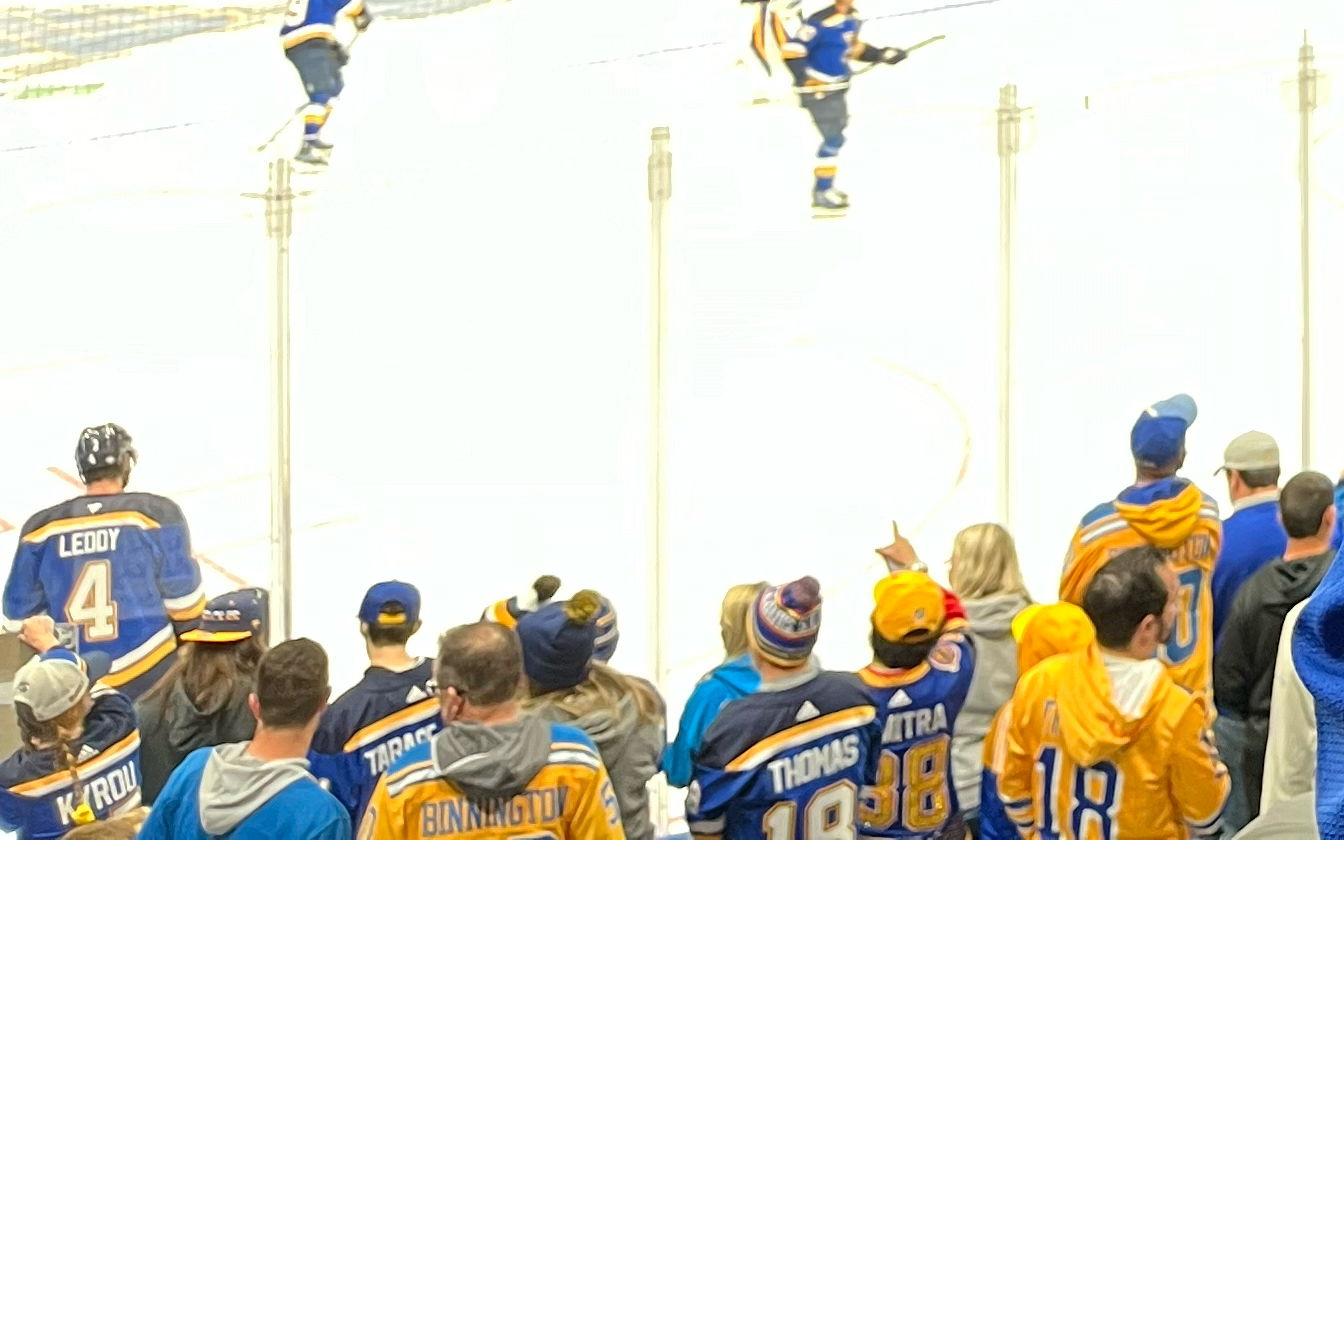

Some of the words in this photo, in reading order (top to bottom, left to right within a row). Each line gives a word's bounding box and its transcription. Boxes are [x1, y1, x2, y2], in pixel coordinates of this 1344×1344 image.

[58, 527, 121, 559] LEDDY
[65, 559, 119, 643] 4
[767, 735, 861, 795] THOMAS
[1033, 743, 1123, 840] 18
